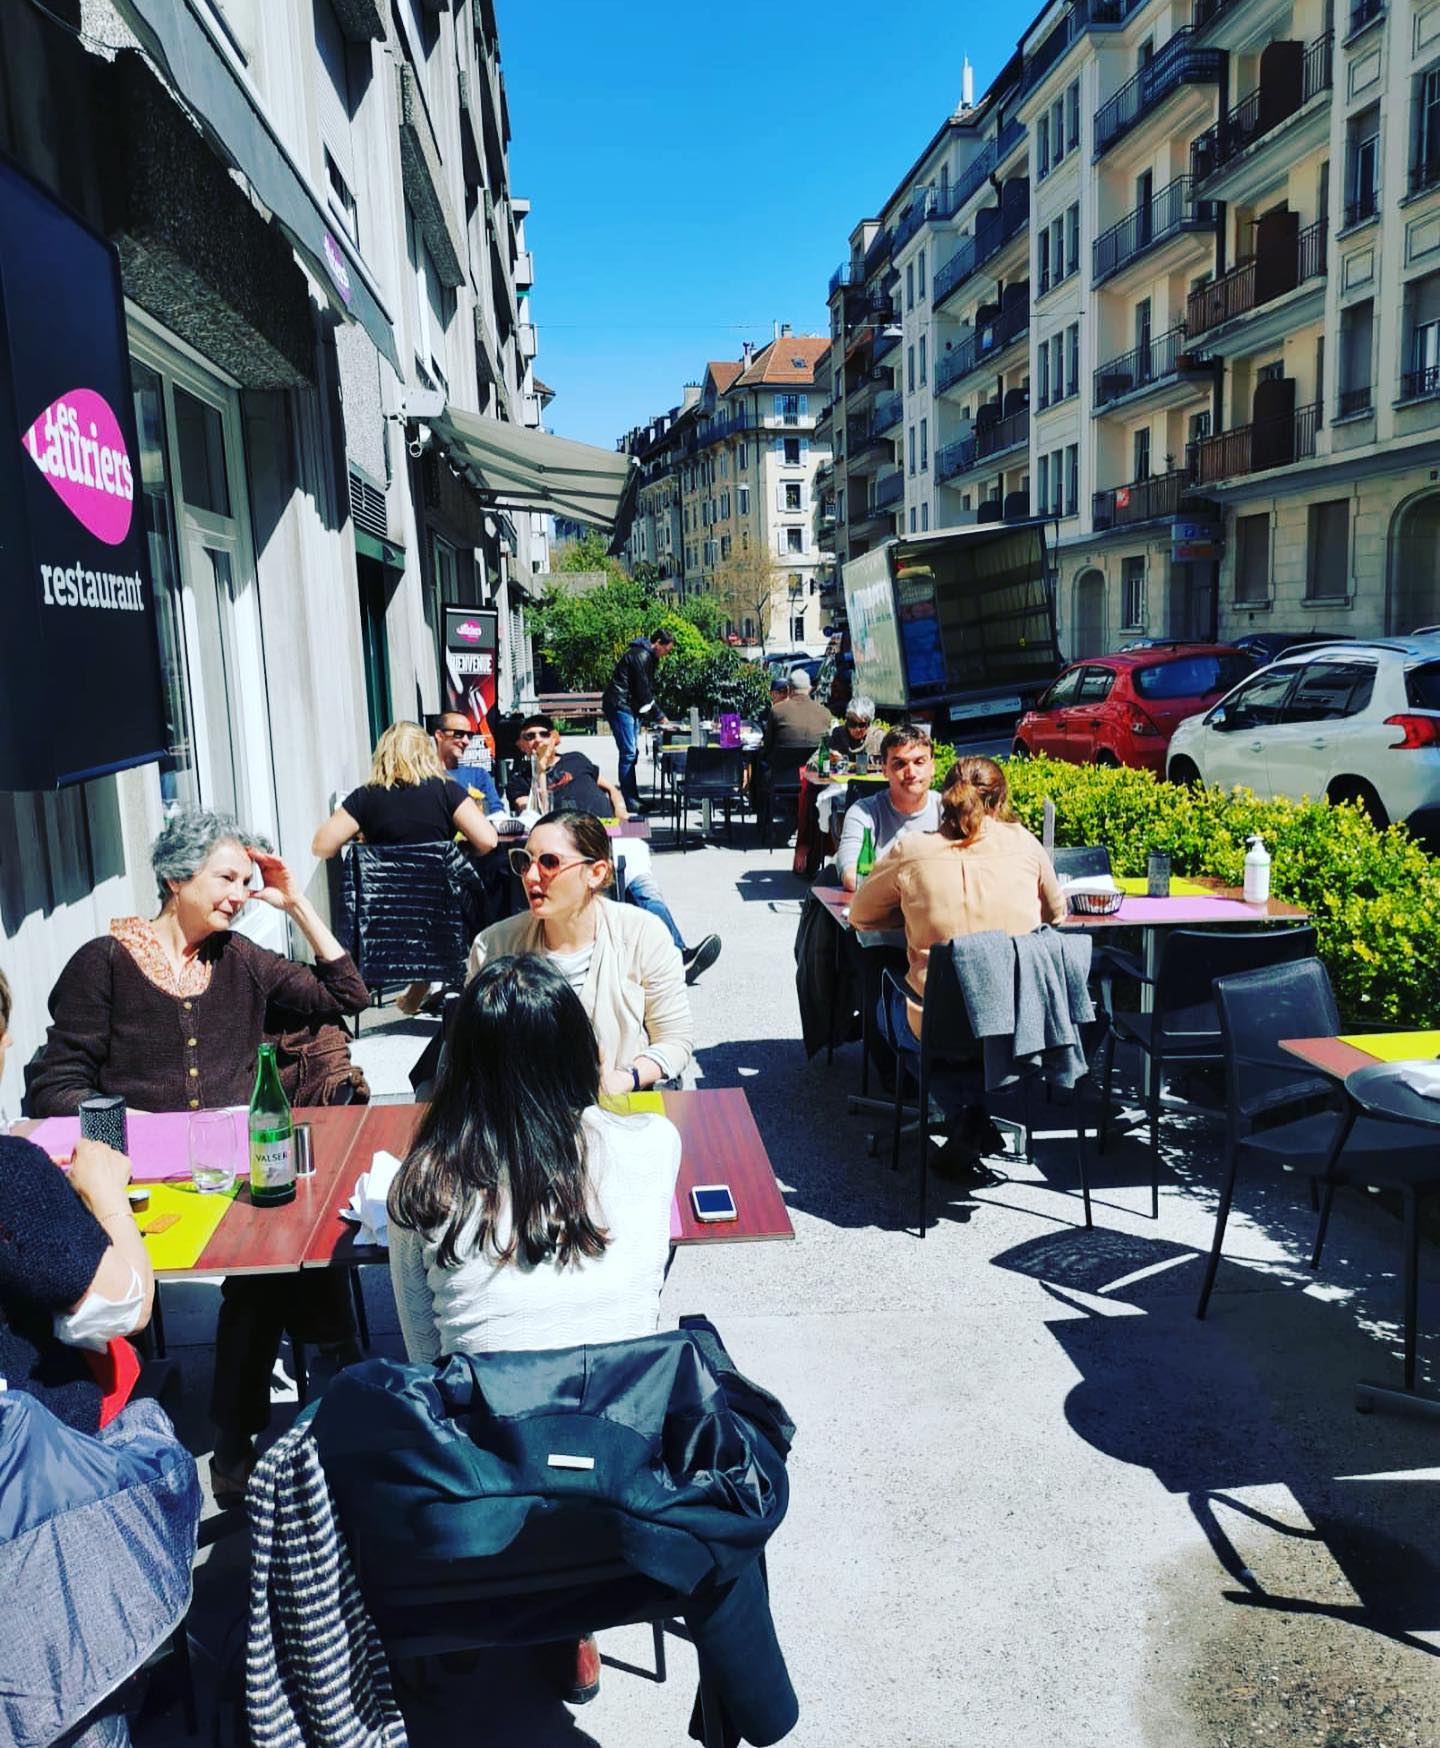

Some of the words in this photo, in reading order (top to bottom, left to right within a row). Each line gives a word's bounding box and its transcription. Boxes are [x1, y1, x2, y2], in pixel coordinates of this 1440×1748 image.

[44, 402, 78, 437] Les
[28, 421, 133, 500] Lauriers
[40, 560, 144, 611] restaurant
[255, 1151, 288, 1163] VALSER
